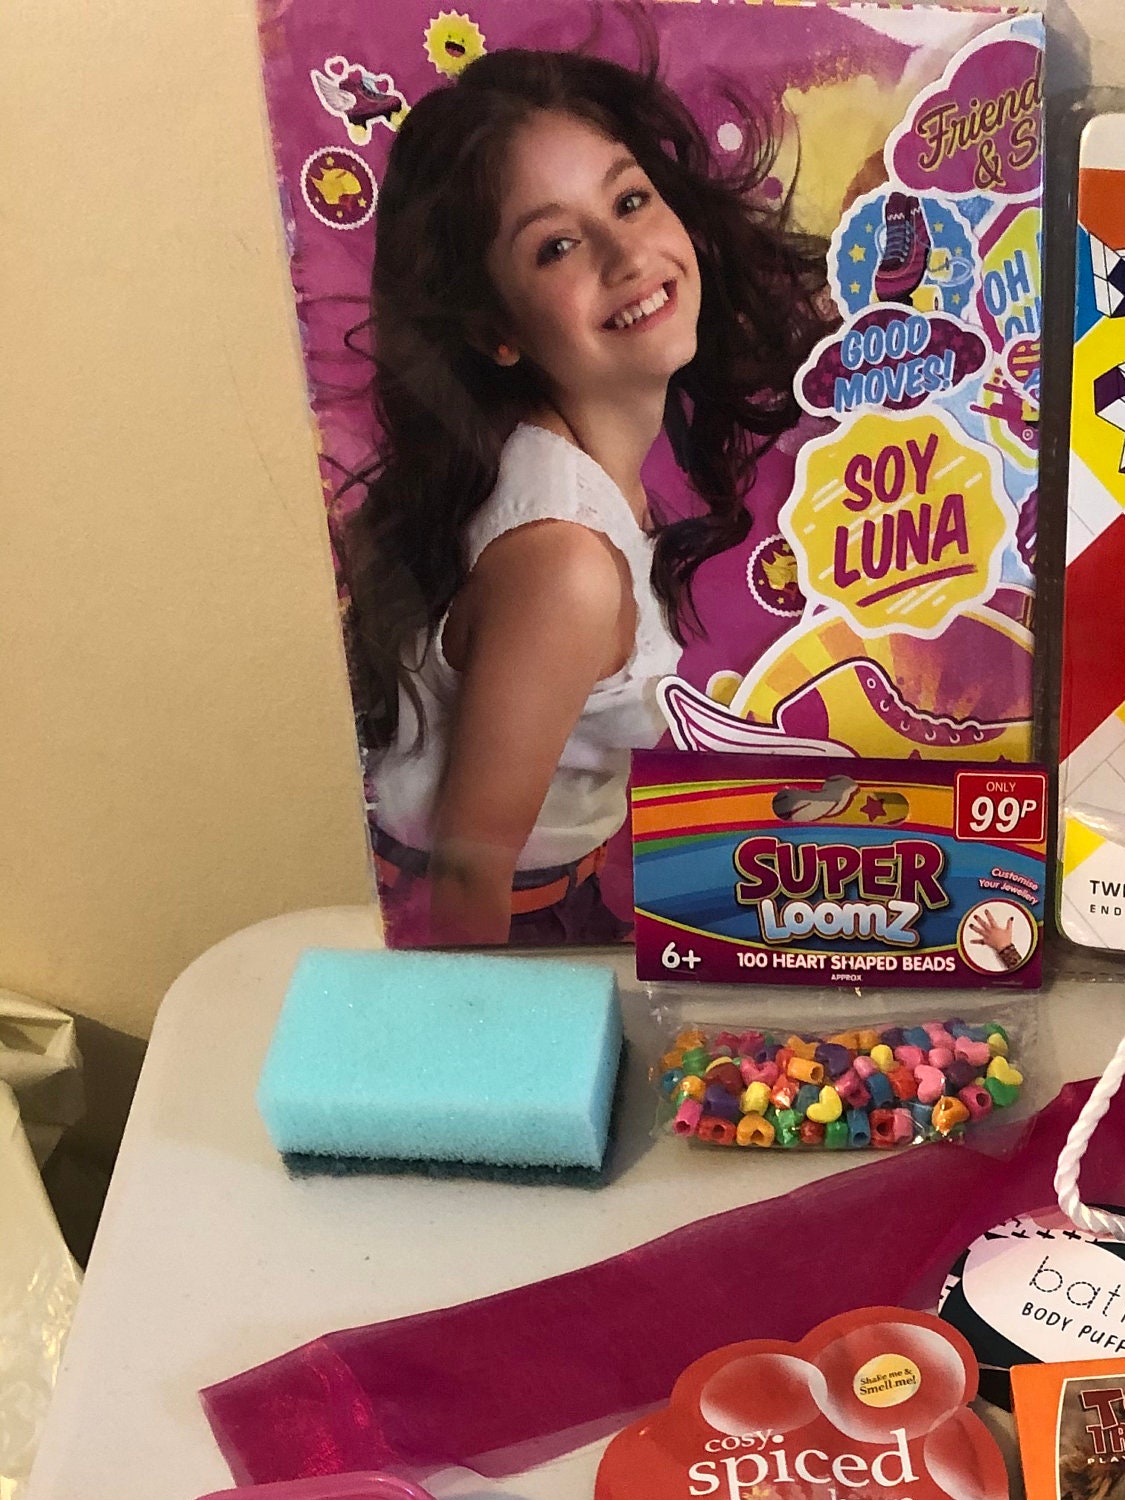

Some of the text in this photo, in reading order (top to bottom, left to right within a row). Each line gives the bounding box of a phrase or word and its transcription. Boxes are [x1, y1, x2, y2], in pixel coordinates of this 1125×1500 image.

[975, 138, 1005, 191] &
[984, 250, 1030, 316] OH
[841, 315, 929, 370] GOOD
[834, 349, 954, 413] MOVES!
[843, 433, 938, 512] SOY
[834, 493, 969, 589] LUNA
[986, 781, 1016, 792] ONLY
[733, 836, 949, 909] SUPER
[979, 879, 1000, 888] Your
[661, 942, 702, 970] 6+
[736, 953, 956, 972] 100 HEART SHAPED BEADS
[1022, 1302, 1074, 1332] BODY
[860, 1374, 887, 1385] Shake
[889, 1370, 903, 1378] me
[860, 1375, 917, 1395] Smell me!
[705, 1429, 773, 1453] cosy
